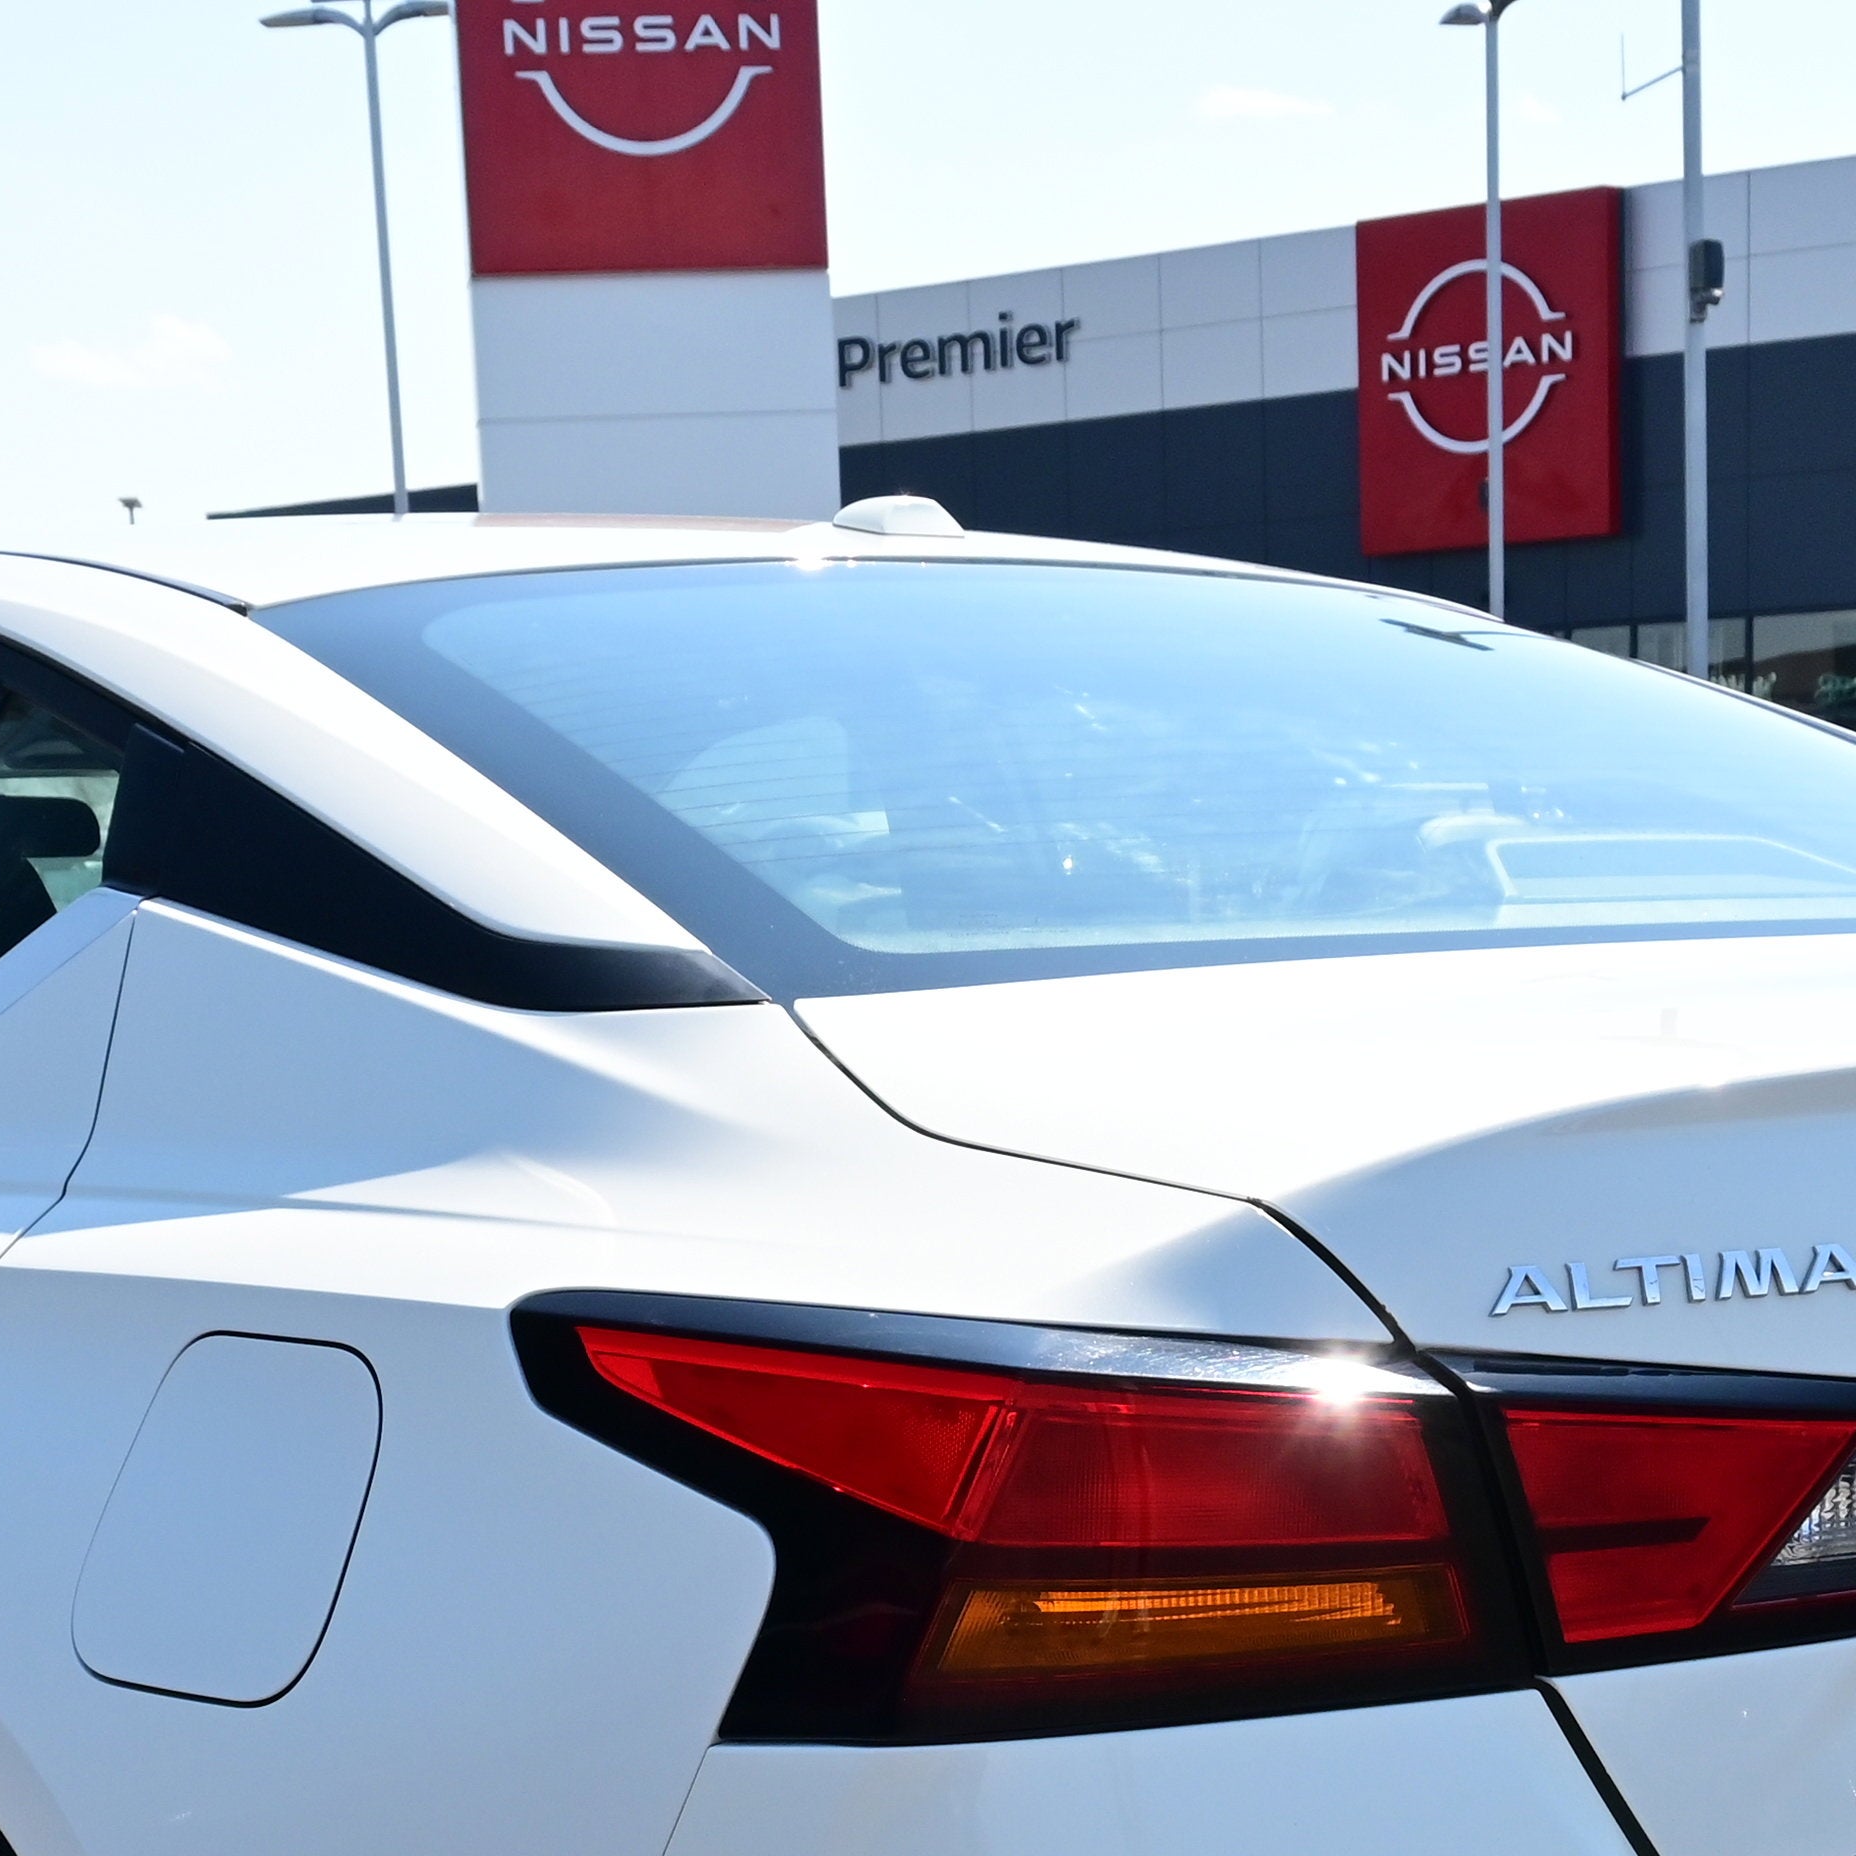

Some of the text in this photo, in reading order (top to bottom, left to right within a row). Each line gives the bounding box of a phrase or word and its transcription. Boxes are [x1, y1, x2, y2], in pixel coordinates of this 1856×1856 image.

[502, 13, 781, 55] NISSAN
[837, 310, 1081, 388] Premier
[1381, 330, 1573, 383] NISSAN
